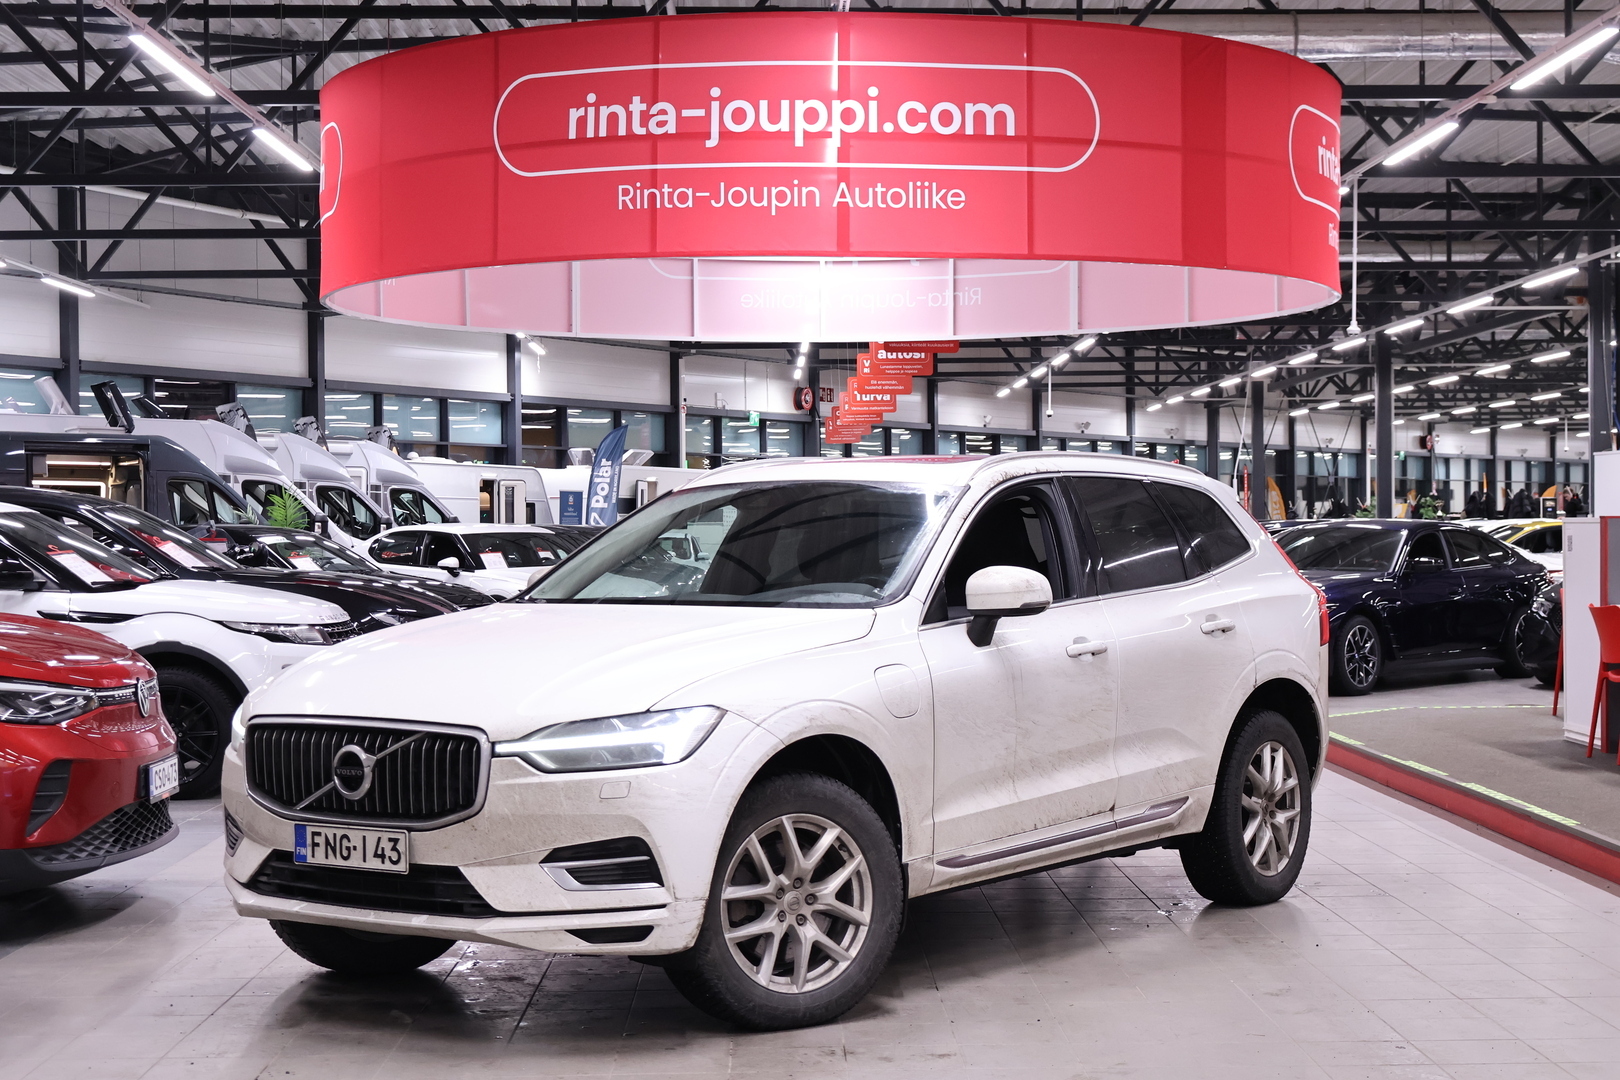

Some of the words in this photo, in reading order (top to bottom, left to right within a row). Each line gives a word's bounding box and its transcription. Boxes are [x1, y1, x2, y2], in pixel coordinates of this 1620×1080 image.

[568, 86, 1015, 148] rinta-jouppi.com
[618, 178, 821, 216] Rinta-Joupin
[833, 181, 966, 210] Autoliike
[591, 458, 612, 508] Polar
[336, 768, 363, 776] VOLVO
[296, 846, 307, 856] FIN
[311, 831, 402, 866] FNG-143
